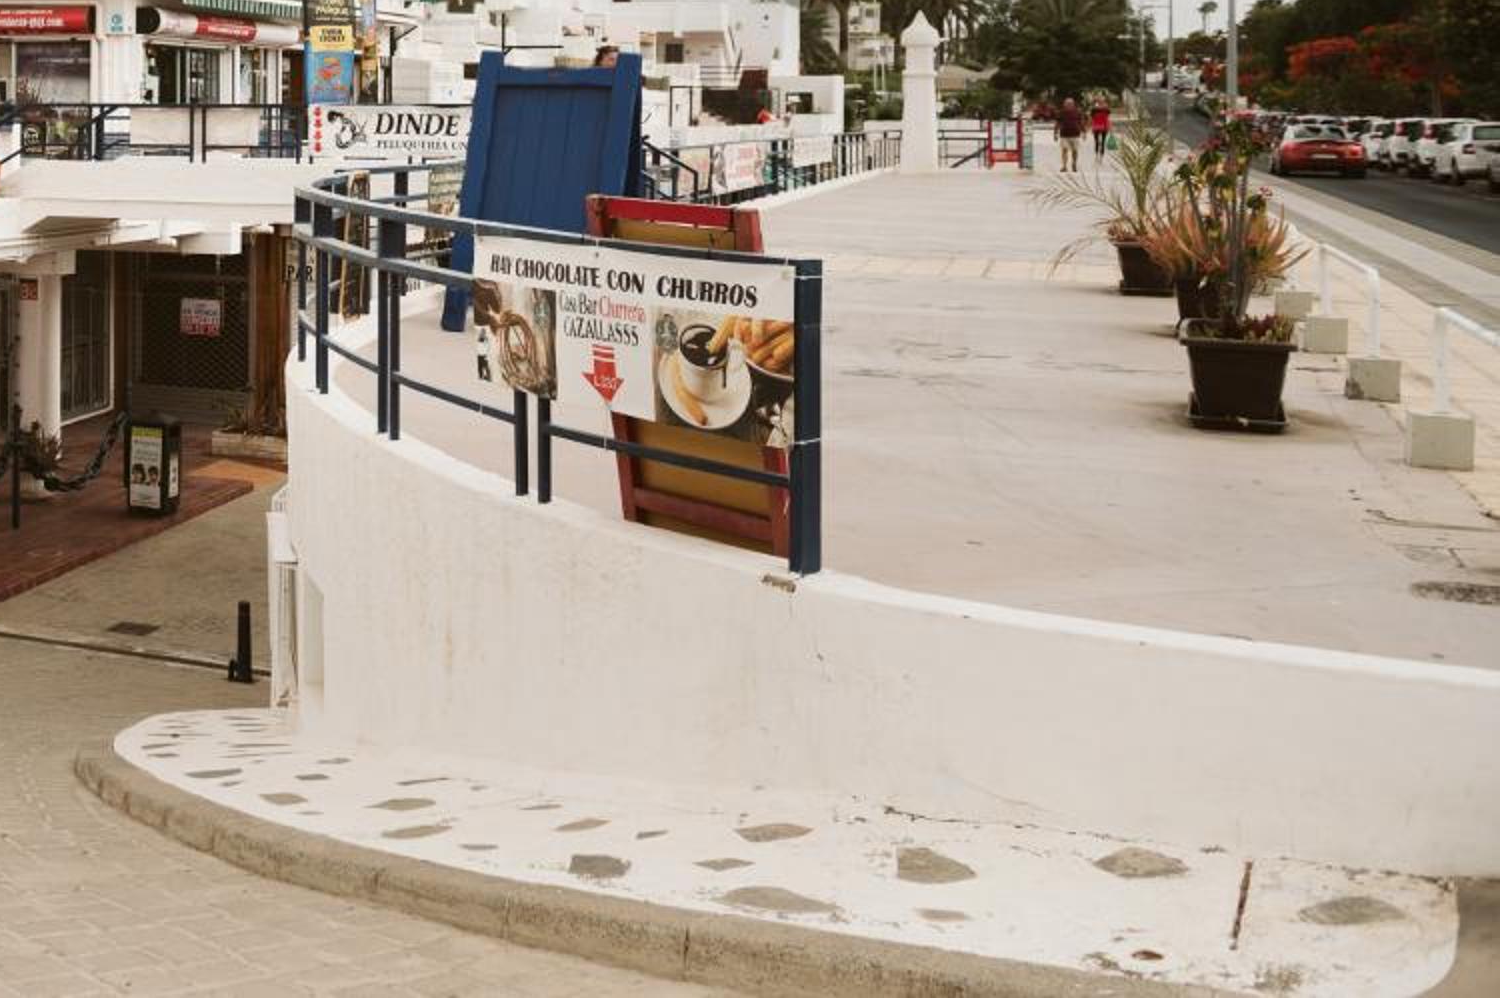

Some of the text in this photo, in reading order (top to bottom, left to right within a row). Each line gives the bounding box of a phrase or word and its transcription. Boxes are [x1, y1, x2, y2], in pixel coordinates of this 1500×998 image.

[374, 112, 462, 137] DINDE
[490, 253, 758, 308] HAY CHOCOLATE CON CHURROS
[579, 292, 597, 315] Bar
